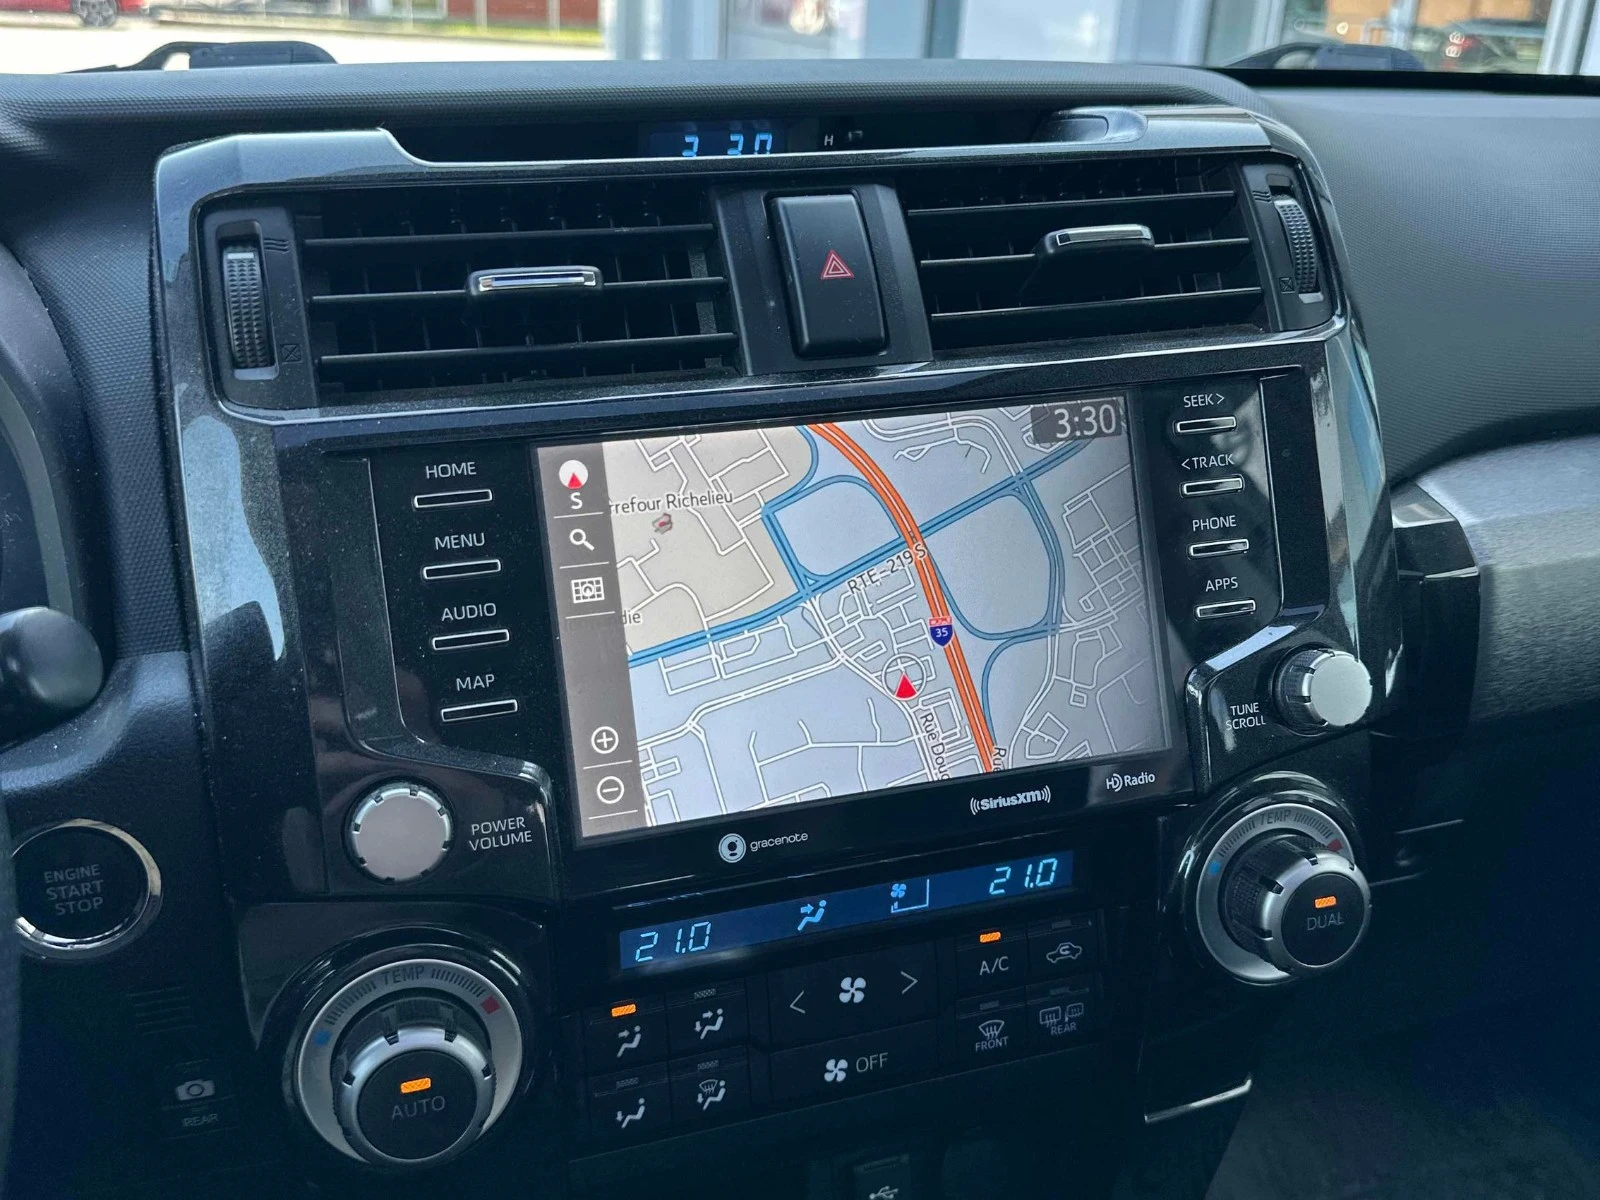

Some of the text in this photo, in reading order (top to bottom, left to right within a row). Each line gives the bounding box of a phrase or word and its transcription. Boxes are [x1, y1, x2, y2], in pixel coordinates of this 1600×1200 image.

[1054, 403, 1116, 439] 3:30
[425, 461, 477, 480] HOME
[570, 492, 583, 509] S
[666, 491, 733, 510] Richelieu
[1192, 515, 1237, 531] PHONE
[434, 532, 485, 550] MENU
[847, 543, 926, 594] RTE-219 S
[1205, 576, 1239, 592] APPS
[441, 602, 497, 622] AUDIO
[935, 627, 949, 638] 35
[456, 673, 496, 691] MAP
[1230, 702, 1260, 717] TUNE
[920, 712, 937, 741] Rue
[1225, 714, 1267, 731] SCROLL
[1106, 772, 1156, 792] HD Radio
[471, 816, 526, 836] POWER
[1260, 809, 1291, 826] TEMP
[468, 830, 533, 851] VOLUME
[749, 831, 809, 853] gracenote
[44, 863, 100, 884] ENGINE
[989, 857, 1058, 896] 21.0
[46, 880, 104, 900] START
[55, 896, 104, 916] STOP
[1306, 911, 1344, 931] DUAL
[634, 920, 712, 963] 21.0
[979, 955, 1009, 976] A/C
[381, 966, 425, 988] TEMP
[1050, 1022, 1077, 1036] REAR
[975, 1035, 1009, 1052] FRONT
[855, 1053, 889, 1074] OFF
[392, 1095, 446, 1120] AUTO
